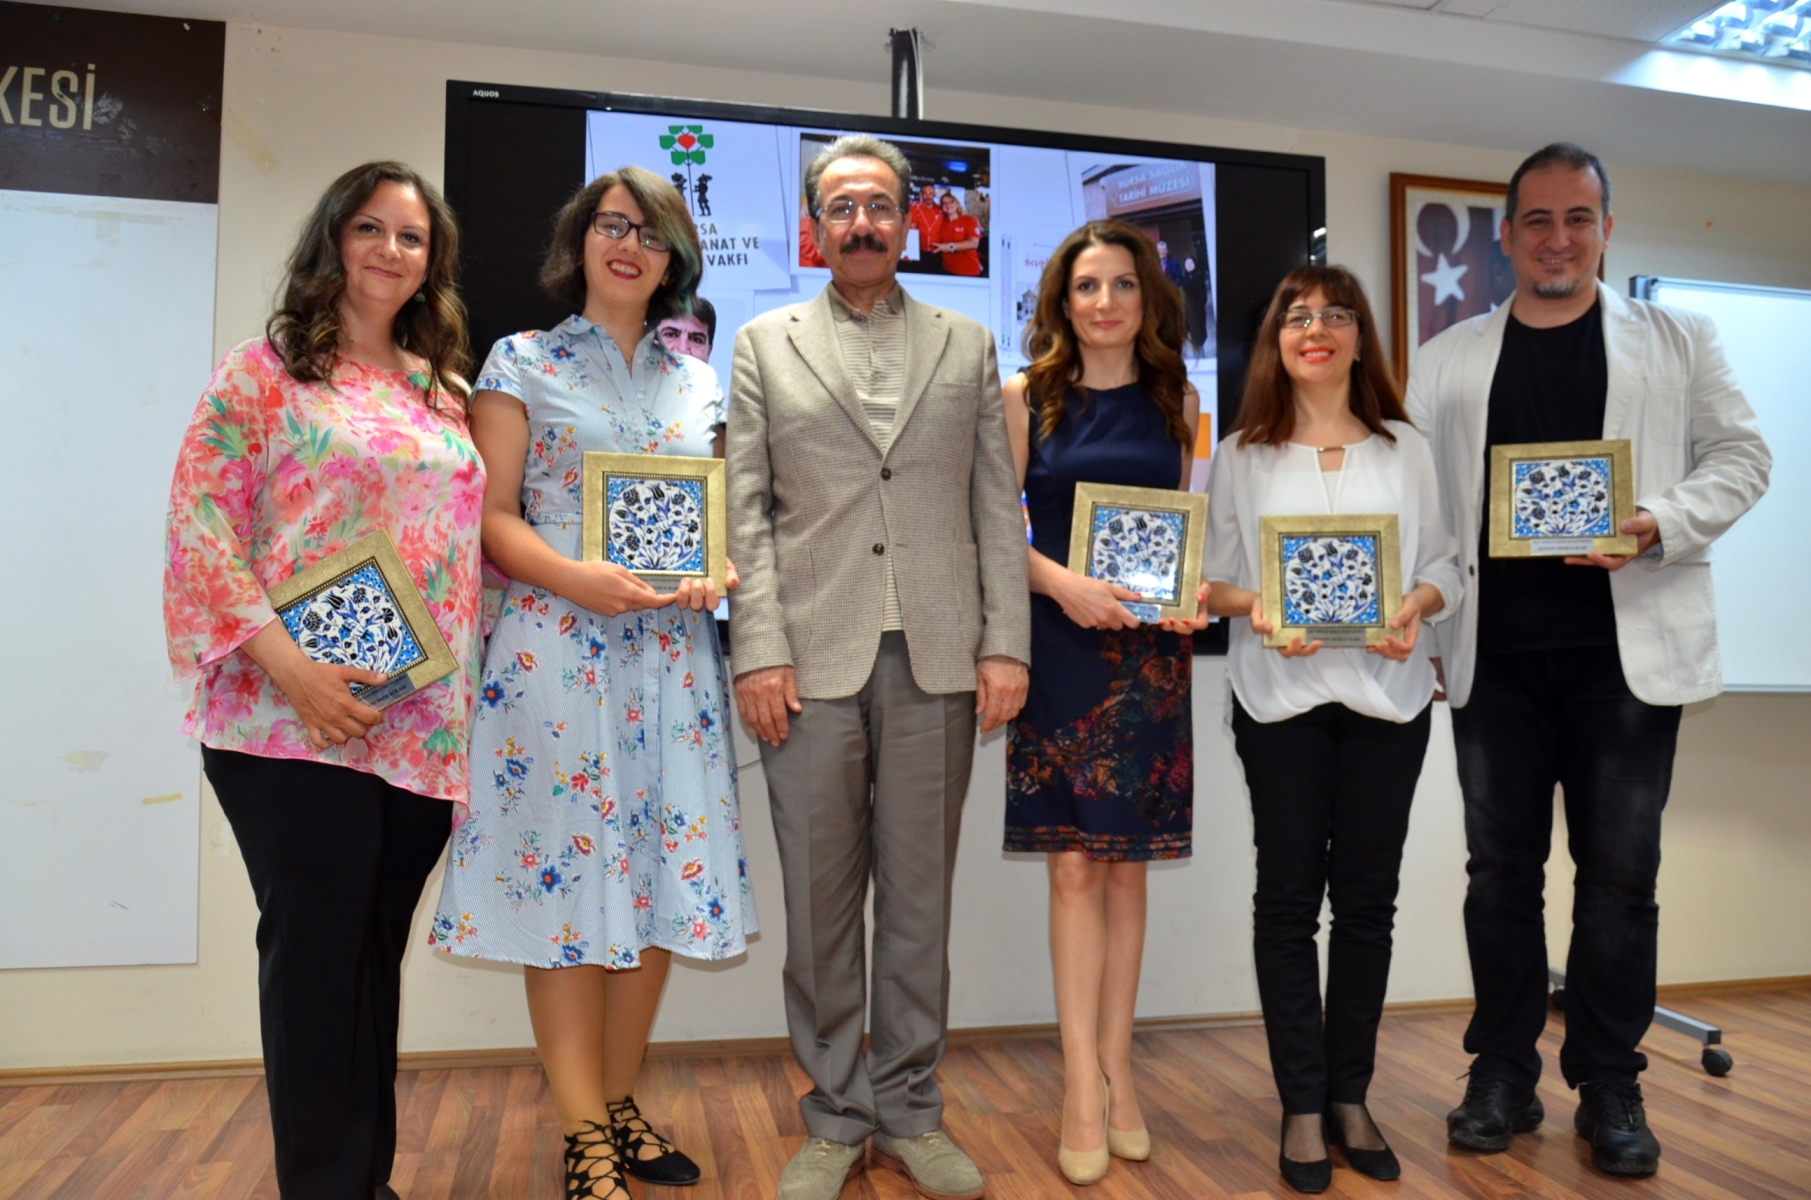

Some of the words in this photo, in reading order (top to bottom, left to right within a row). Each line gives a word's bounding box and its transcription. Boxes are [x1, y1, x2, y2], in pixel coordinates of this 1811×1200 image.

[472, 89, 500, 98] AQUOS
[696, 222, 718, 235] SA
[742, 237, 760, 250] VE
[707, 253, 748, 266] VAKFI
